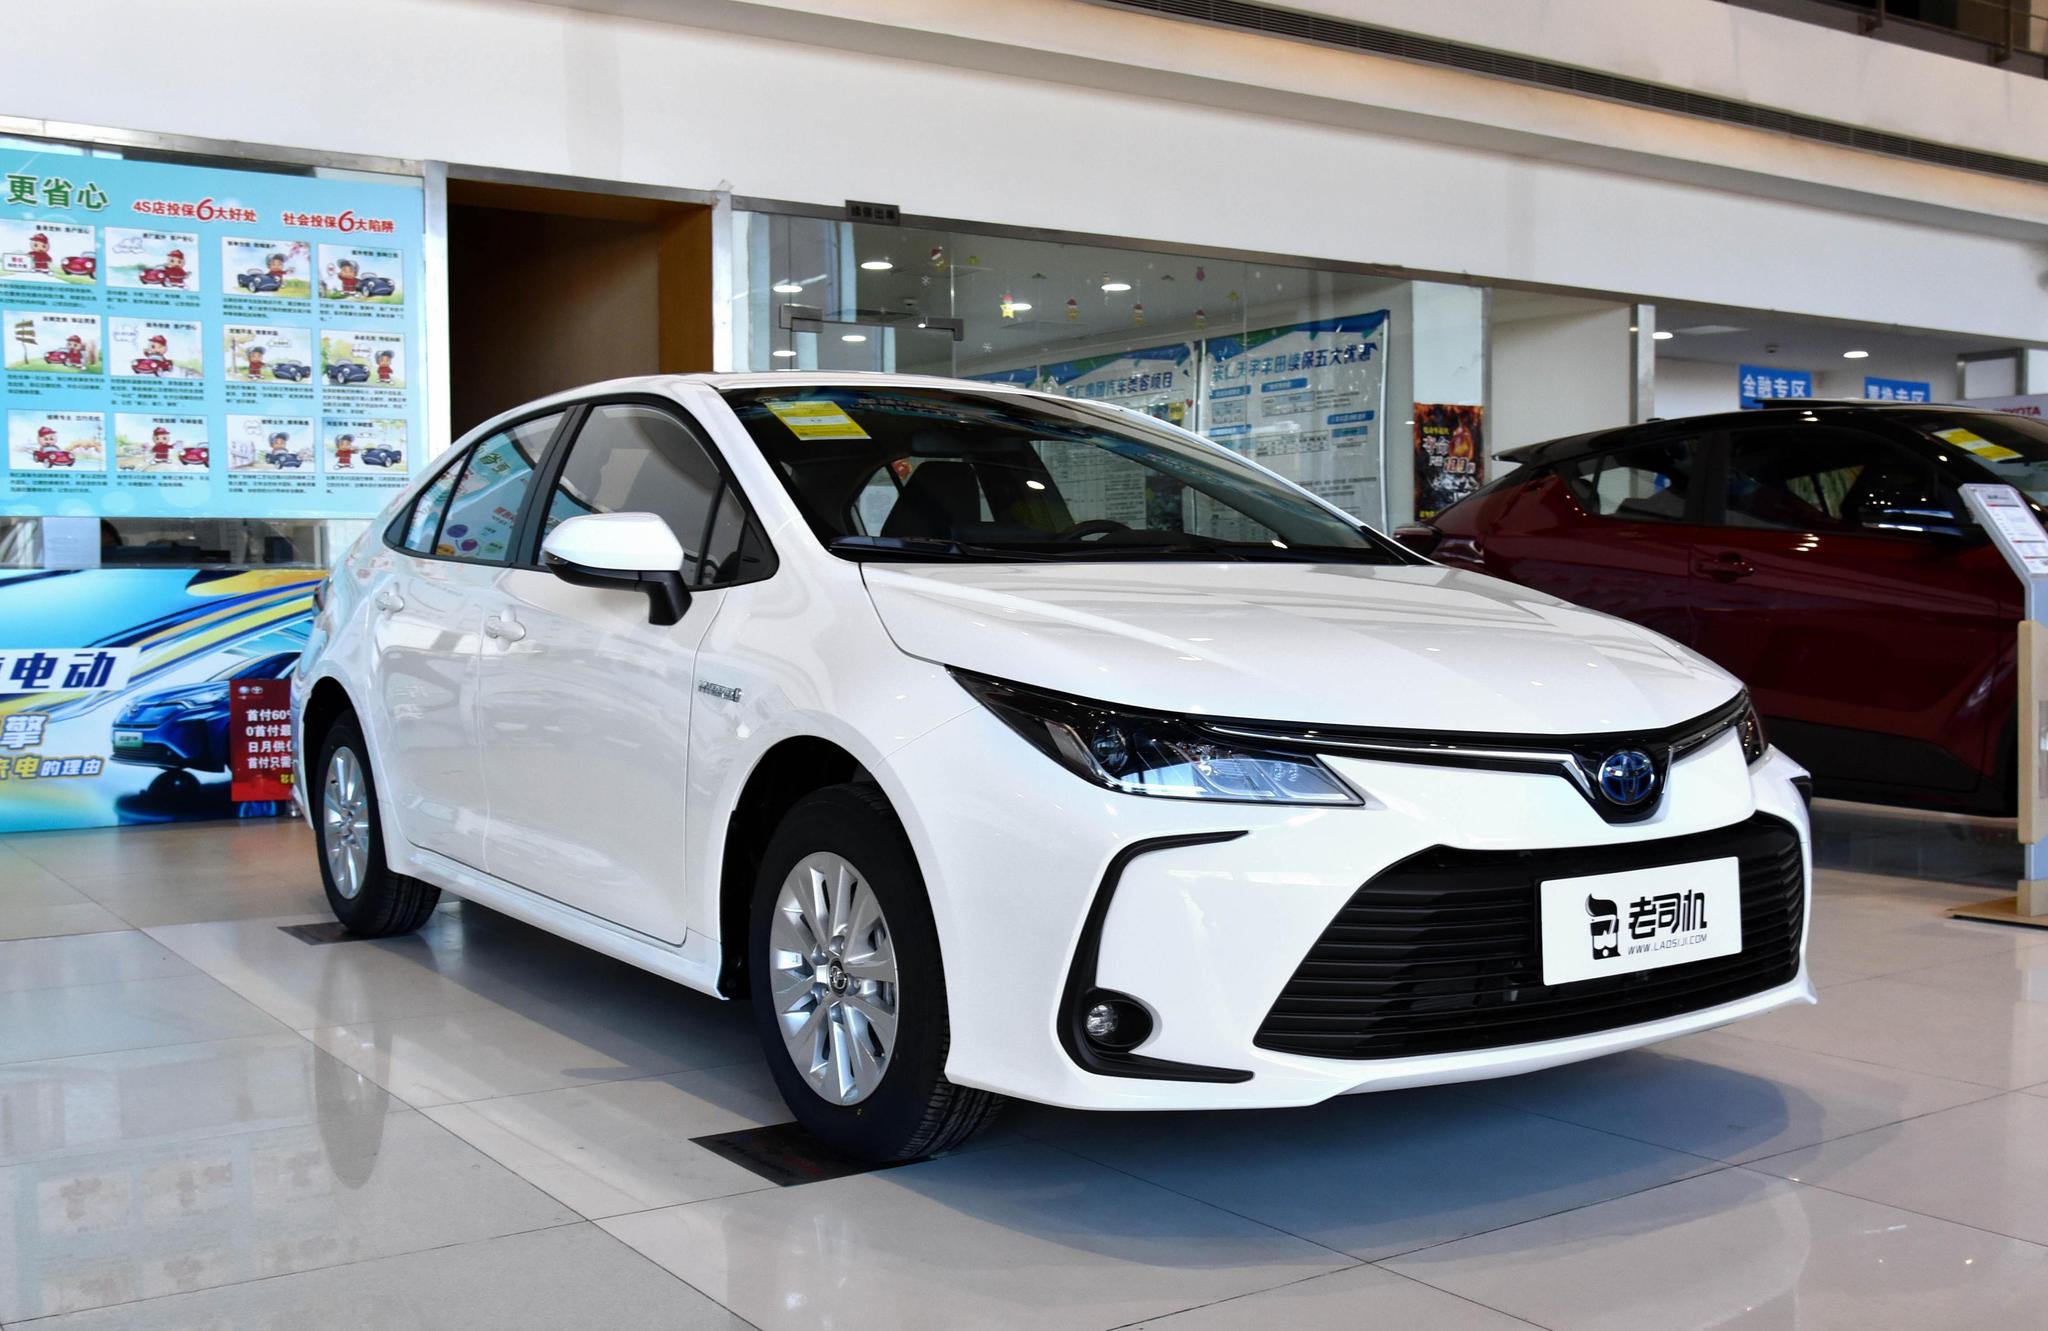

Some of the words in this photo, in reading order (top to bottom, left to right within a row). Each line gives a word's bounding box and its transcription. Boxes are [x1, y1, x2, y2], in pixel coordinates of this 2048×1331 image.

[7, 174, 108, 209] 更省心
[133, 199, 257, 223] 4S店投保6大好处
[283, 210, 394, 233] 社会投保6大陷阱
[1742, 374, 1806, 399] 金融专区
[0, 651, 117, 689] 电动
[0, 714, 48, 750] 擎
[1628, 889, 1708, 940] 老司机
[1627, 933, 1708, 956] WWW.LAOSIJI.COM
